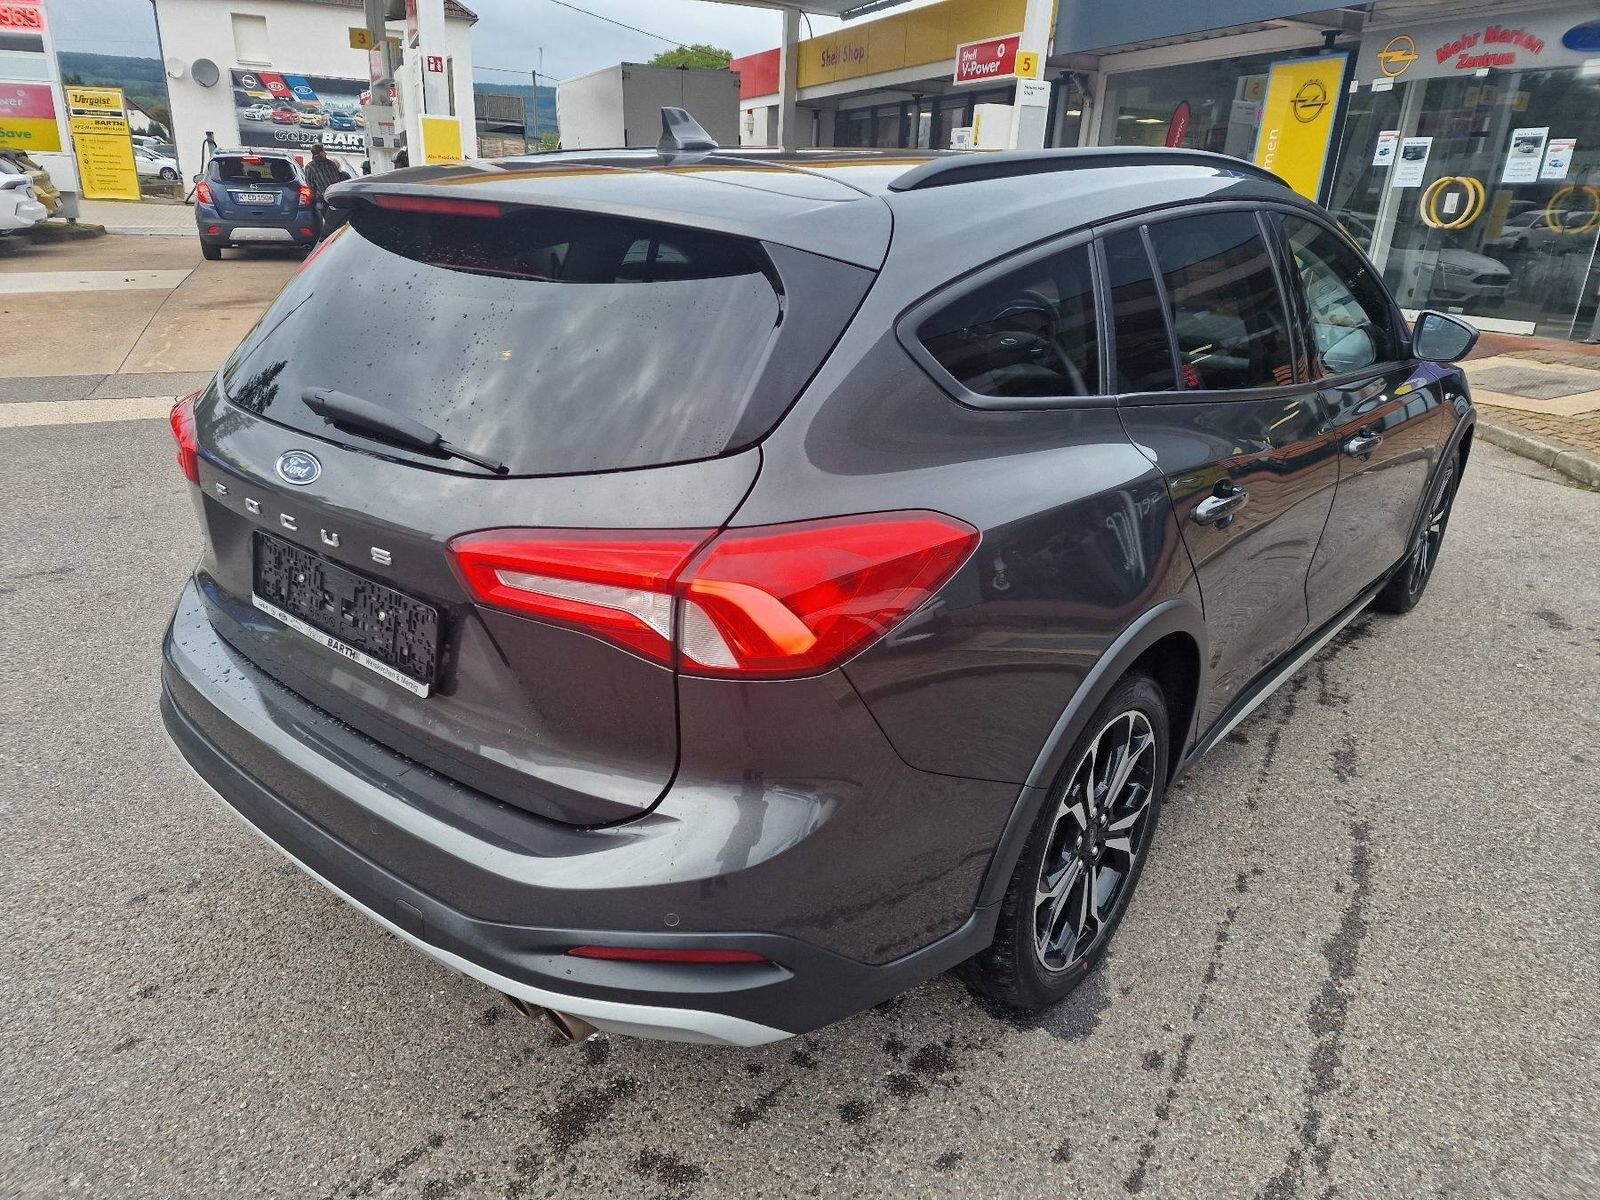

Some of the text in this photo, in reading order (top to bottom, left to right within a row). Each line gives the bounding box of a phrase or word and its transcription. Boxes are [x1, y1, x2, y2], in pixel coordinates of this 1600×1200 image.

[359, 33, 366, 44] 3
[1436, 25, 1545, 64] Mehr Marken
[821, 45, 864, 67] Shell Shop
[962, 49, 977, 61] Shell
[1456, 52, 1516, 69] Zentrum
[962, 60, 1000, 77] V-Power
[1022, 58, 1031, 71] 5
[274, 129, 318, 142] Gebr.
[284, 456, 311, 478] Ford
[215, 482, 392, 566] FOCUS
[327, 638, 356, 659] BARTH
